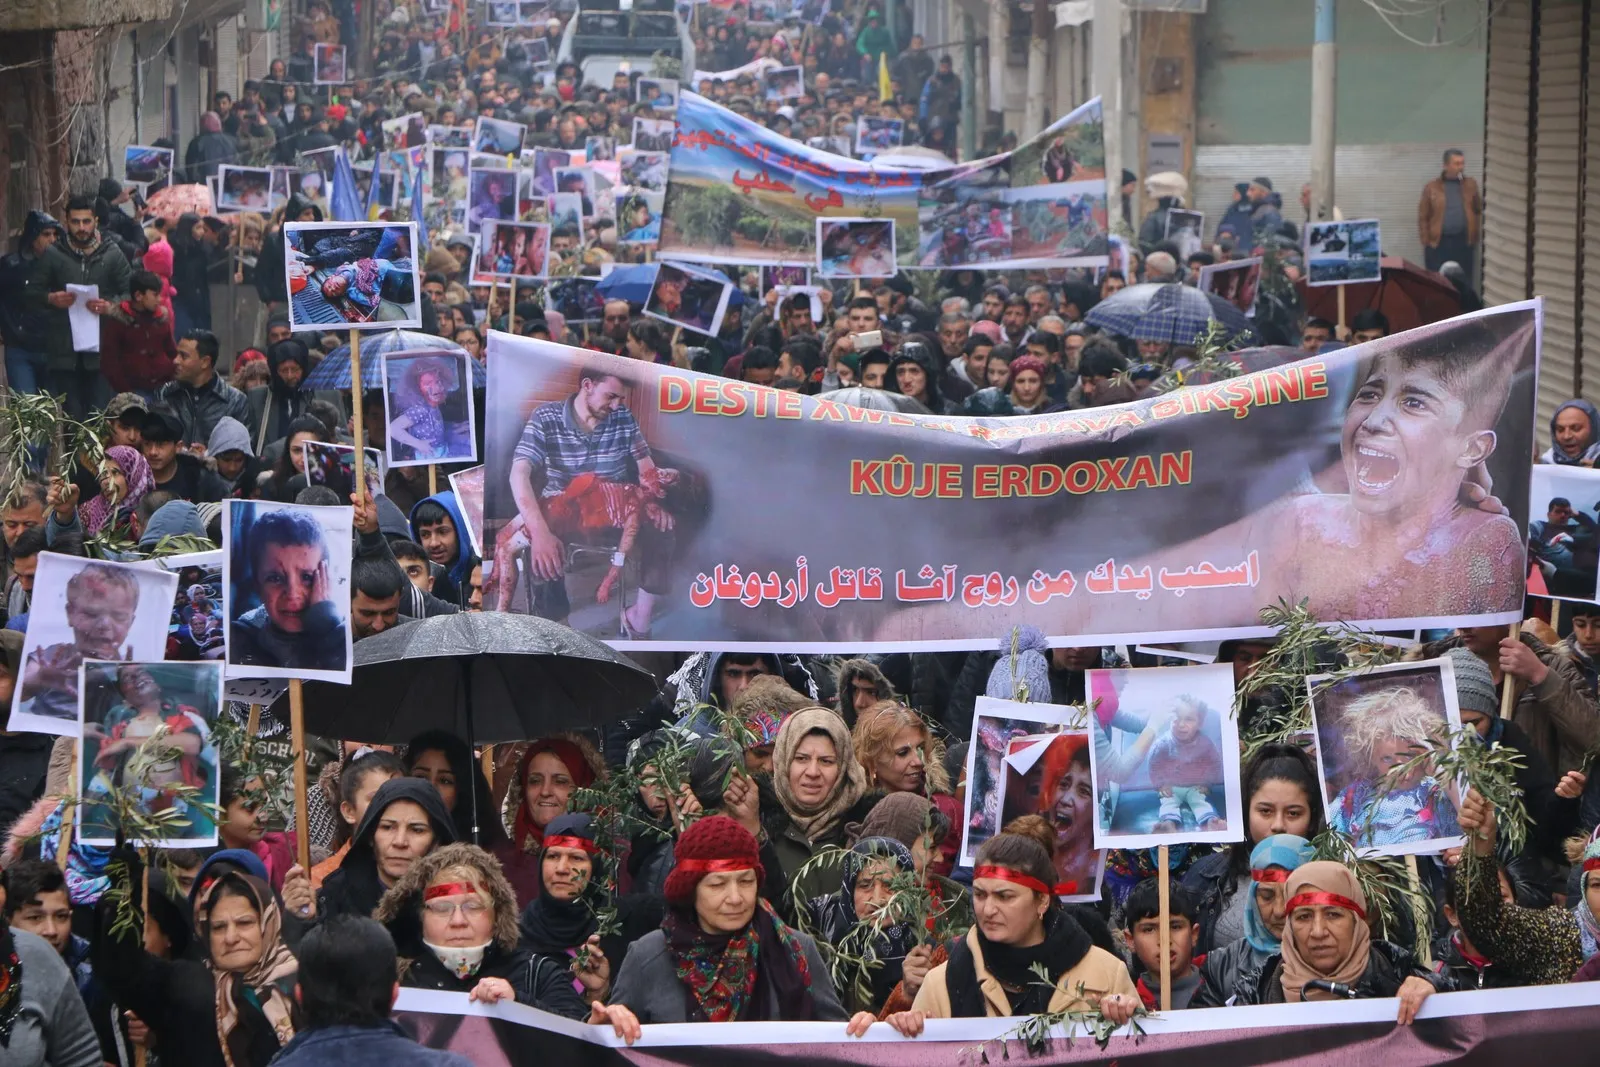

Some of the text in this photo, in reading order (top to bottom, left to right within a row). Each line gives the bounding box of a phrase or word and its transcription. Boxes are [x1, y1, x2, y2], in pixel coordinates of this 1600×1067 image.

[804, 186, 844, 213] في
[658, 374, 802, 420] DESTE
[810, 398, 916, 427] XW
[1152, 362, 1328, 419] BIKŞINE
[850, 450, 1193, 499] KÛJE ERDOXAN
[689, 555, 809, 609] أردوغان
[814, 565, 883, 608] قاتل
[961, 571, 1020, 607] روج
[1025, 568, 1078, 605] من
[1084, 557, 1154, 600] يدك
[1158, 549, 1261, 598] اسحب
[257, 741, 317, 768] SCHL
